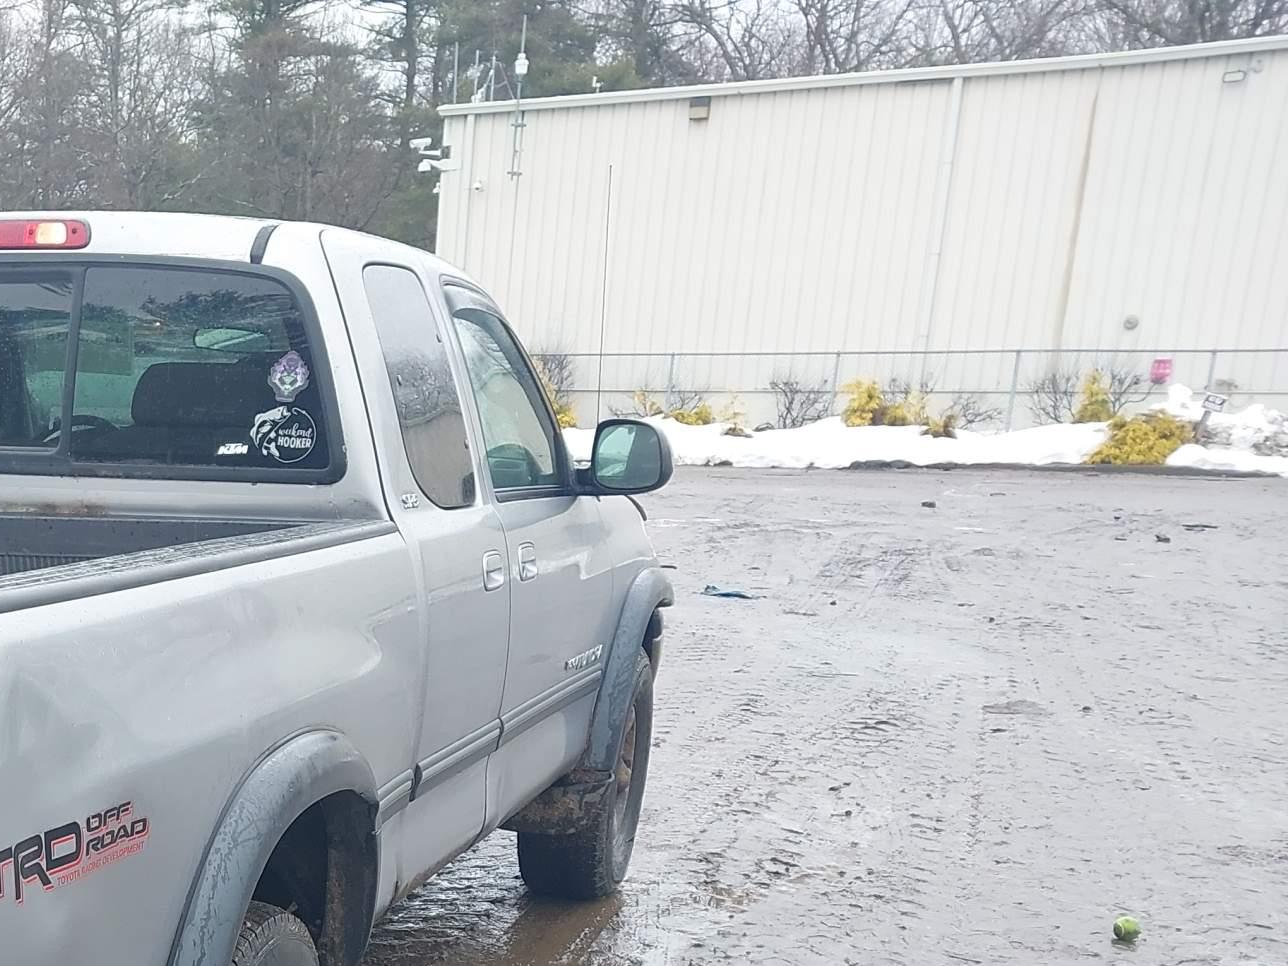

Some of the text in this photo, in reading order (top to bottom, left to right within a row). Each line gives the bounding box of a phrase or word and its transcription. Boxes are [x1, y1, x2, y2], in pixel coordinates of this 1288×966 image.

[217, 443, 249, 455] KTM
[277, 435, 312, 449] HOOKER
[85, 800, 133, 834] OFF
[85, 817, 149, 857] ROAD
